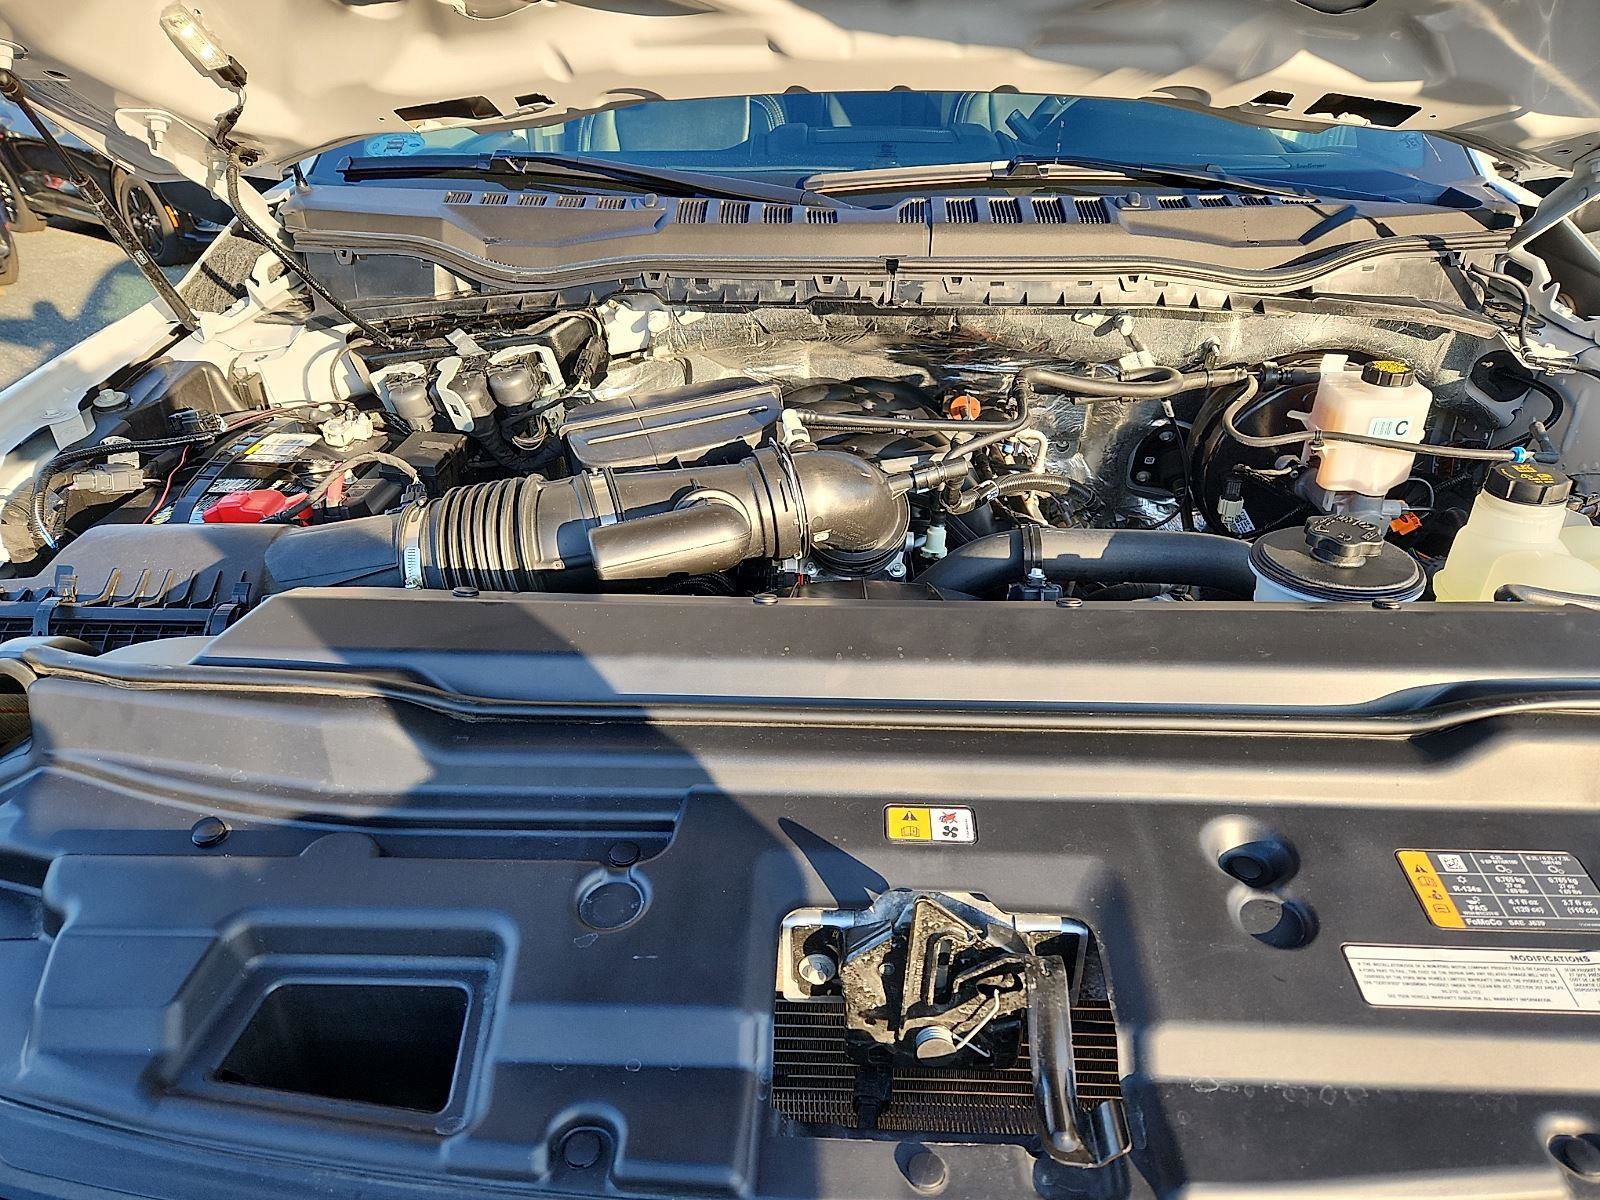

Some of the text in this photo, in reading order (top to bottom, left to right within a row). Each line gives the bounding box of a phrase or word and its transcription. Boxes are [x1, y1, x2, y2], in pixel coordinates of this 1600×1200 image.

[1395, 420, 1409, 436] C
[1465, 918, 1502, 926] FoMoCo
[1510, 954, 1591, 962] MODIFICATIONS
